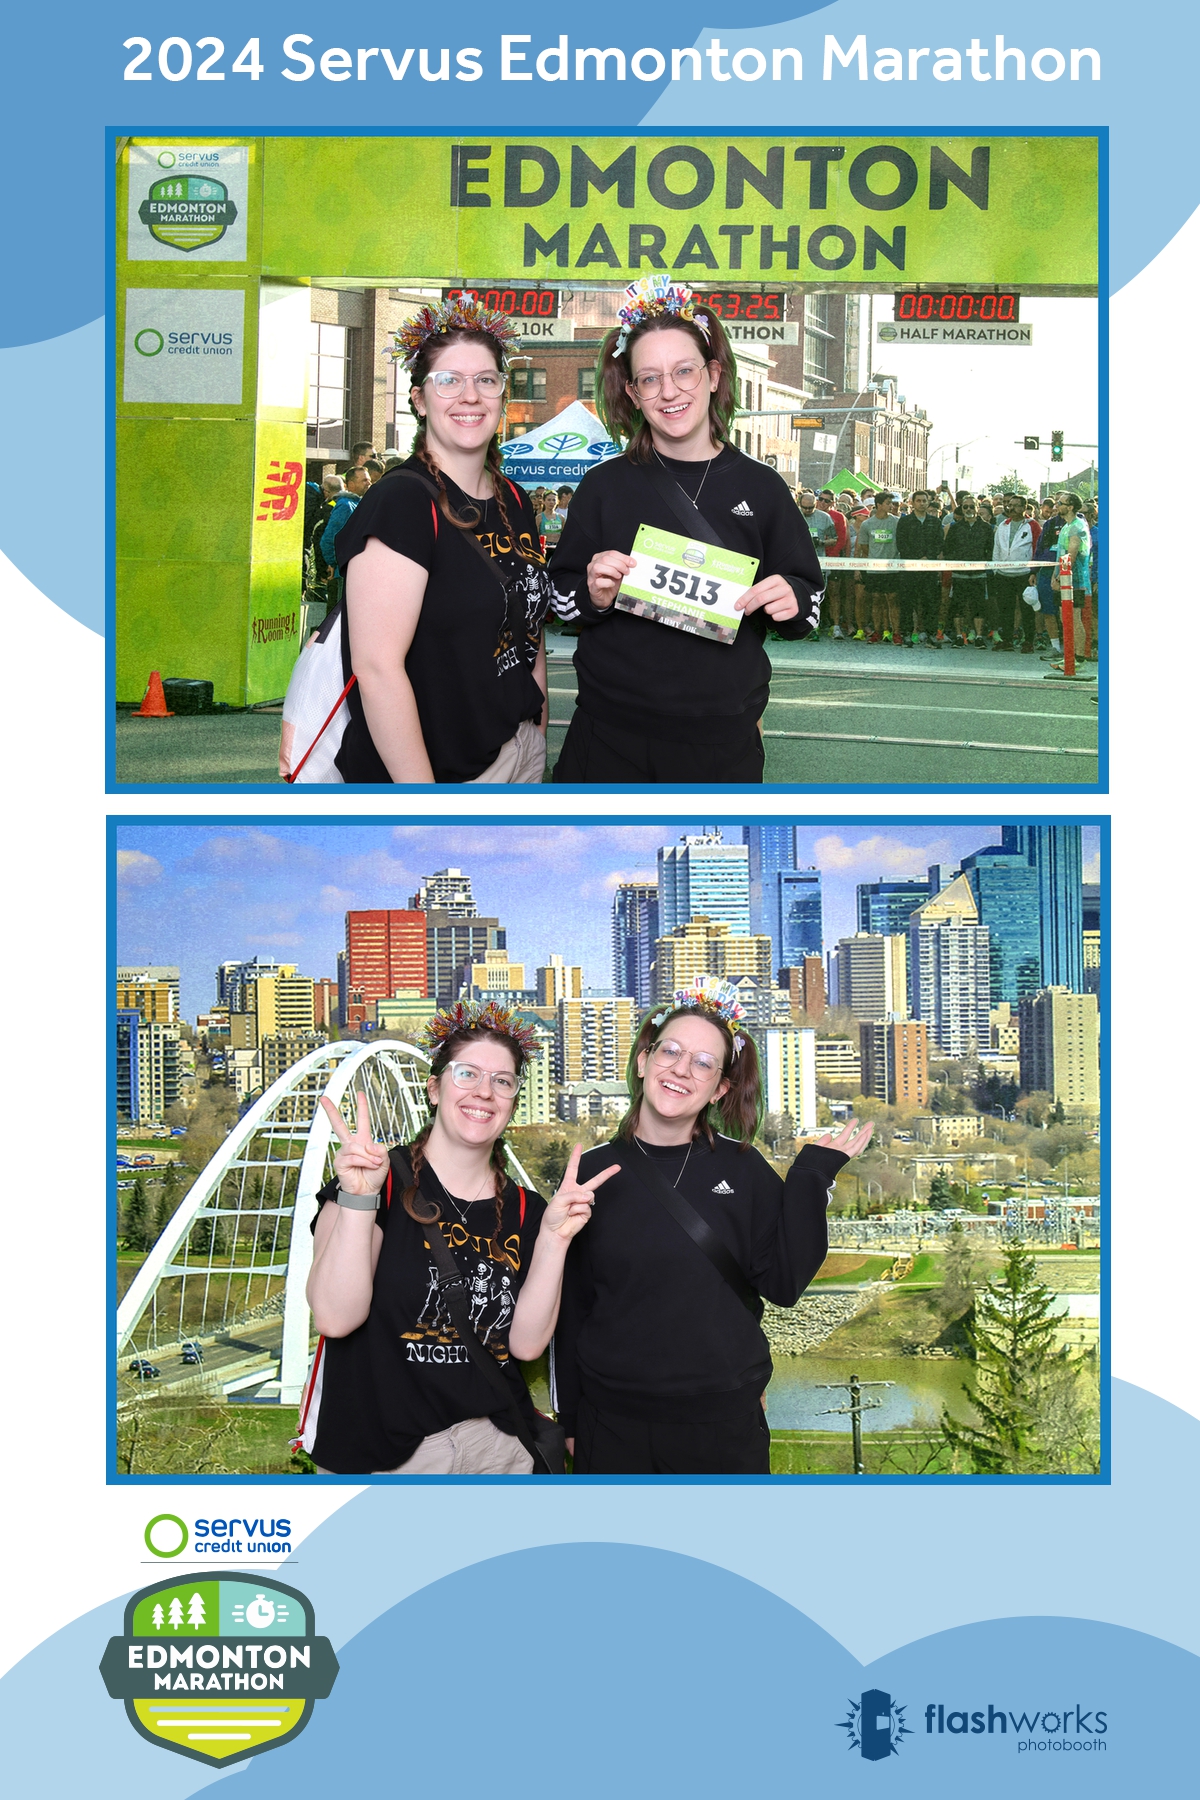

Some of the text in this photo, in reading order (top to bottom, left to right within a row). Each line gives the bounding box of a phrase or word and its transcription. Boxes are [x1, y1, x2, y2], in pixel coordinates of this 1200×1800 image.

[178, 152, 220, 161] servus
[450, 145, 990, 211] EDMONTON
[149, 203, 227, 214] EDMONTON
[160, 214, 215, 222] MARATHON
[523, 222, 906, 272] MARATHON
[626, 275, 669, 298] IT'S MY
[522, 322, 554, 336] 10K
[900, 328, 1031, 341] HALF MARATHON
[168, 331, 233, 345] servus
[168, 345, 233, 355] credit union
[499, 464, 545, 476] servus
[731, 508, 754, 517] adidas
[649, 563, 722, 606] 3513
[650, 595, 706, 620] STEPHANIE
[658, 616, 697, 634] ARMY 10K
[695, 976, 738, 996] IT'S MY
